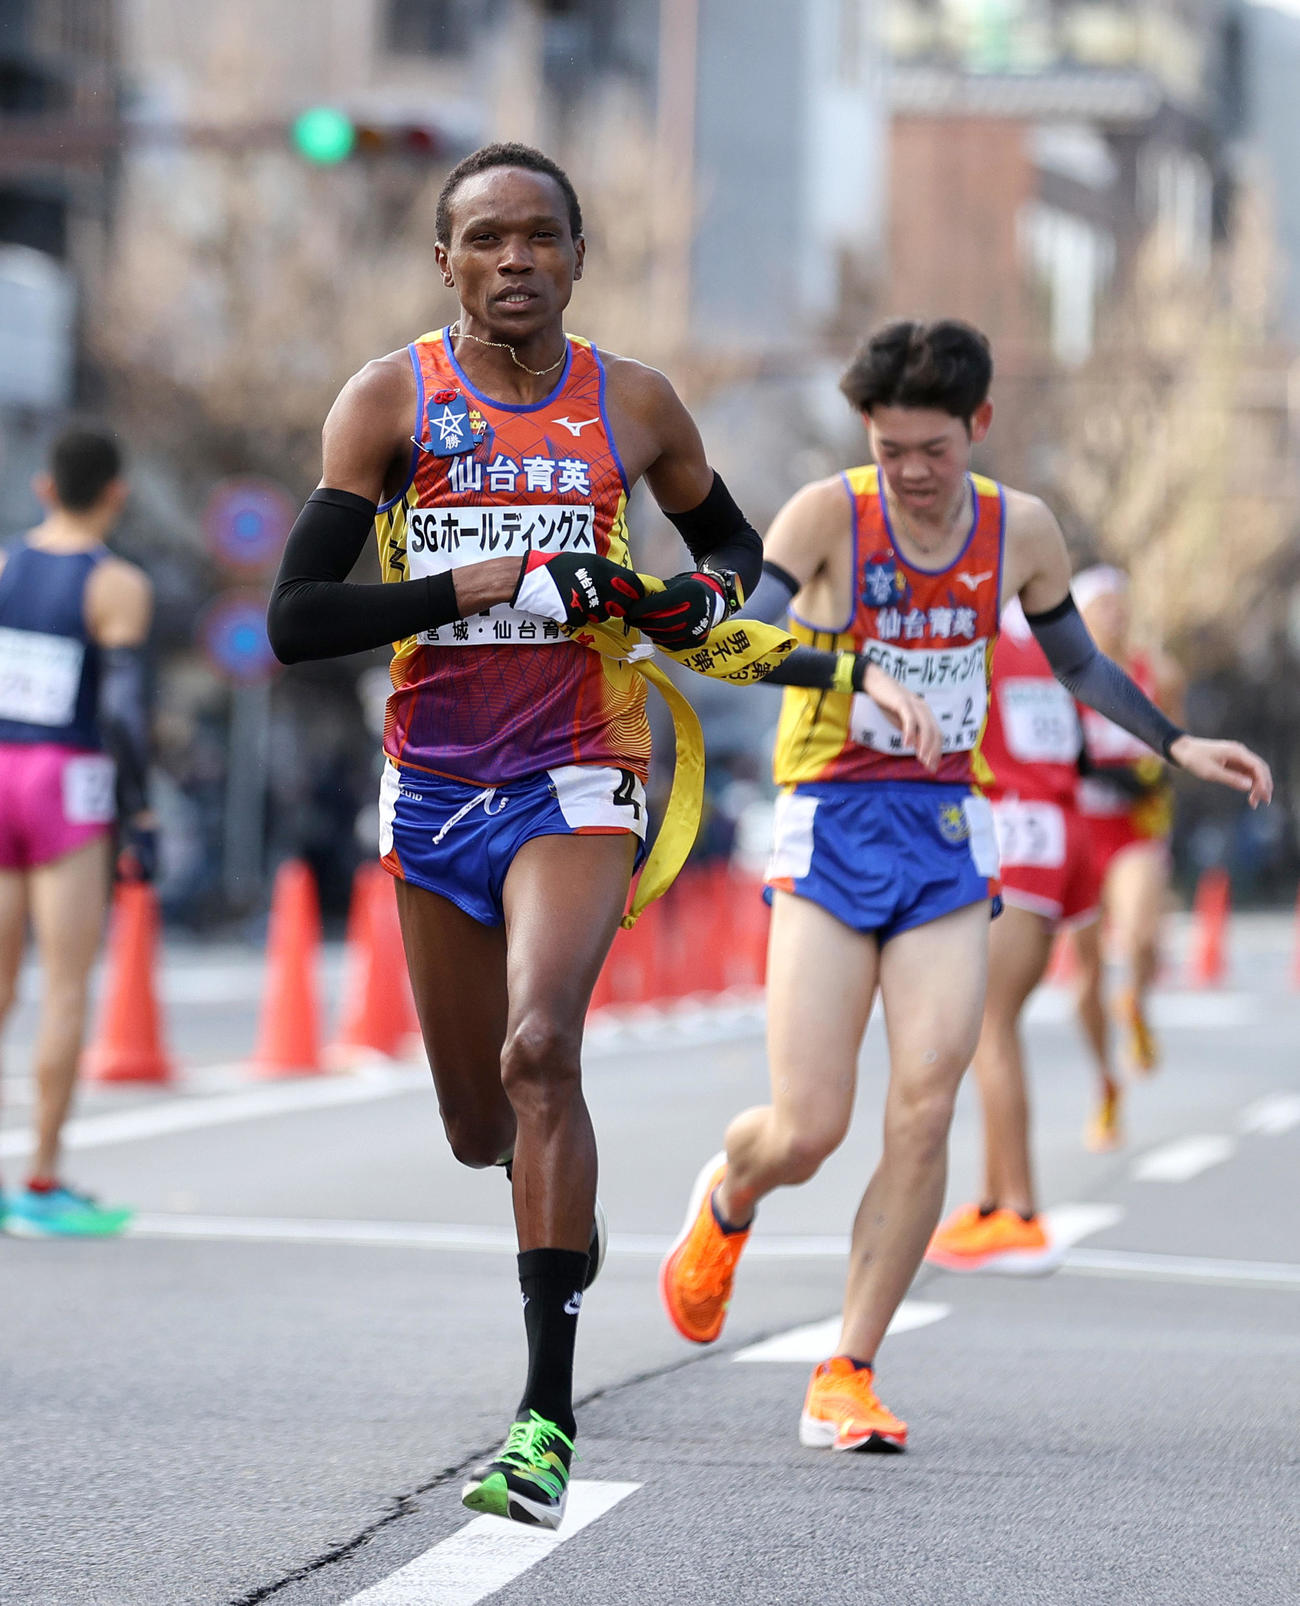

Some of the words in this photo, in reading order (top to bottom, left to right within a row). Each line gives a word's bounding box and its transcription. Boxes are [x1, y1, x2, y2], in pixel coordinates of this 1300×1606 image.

[445, 434, 461, 449] 勝
[448, 455, 591, 496] 仙台育英
[411, 510, 591, 553] SGホールディングス
[613, 767, 641, 820] 4
